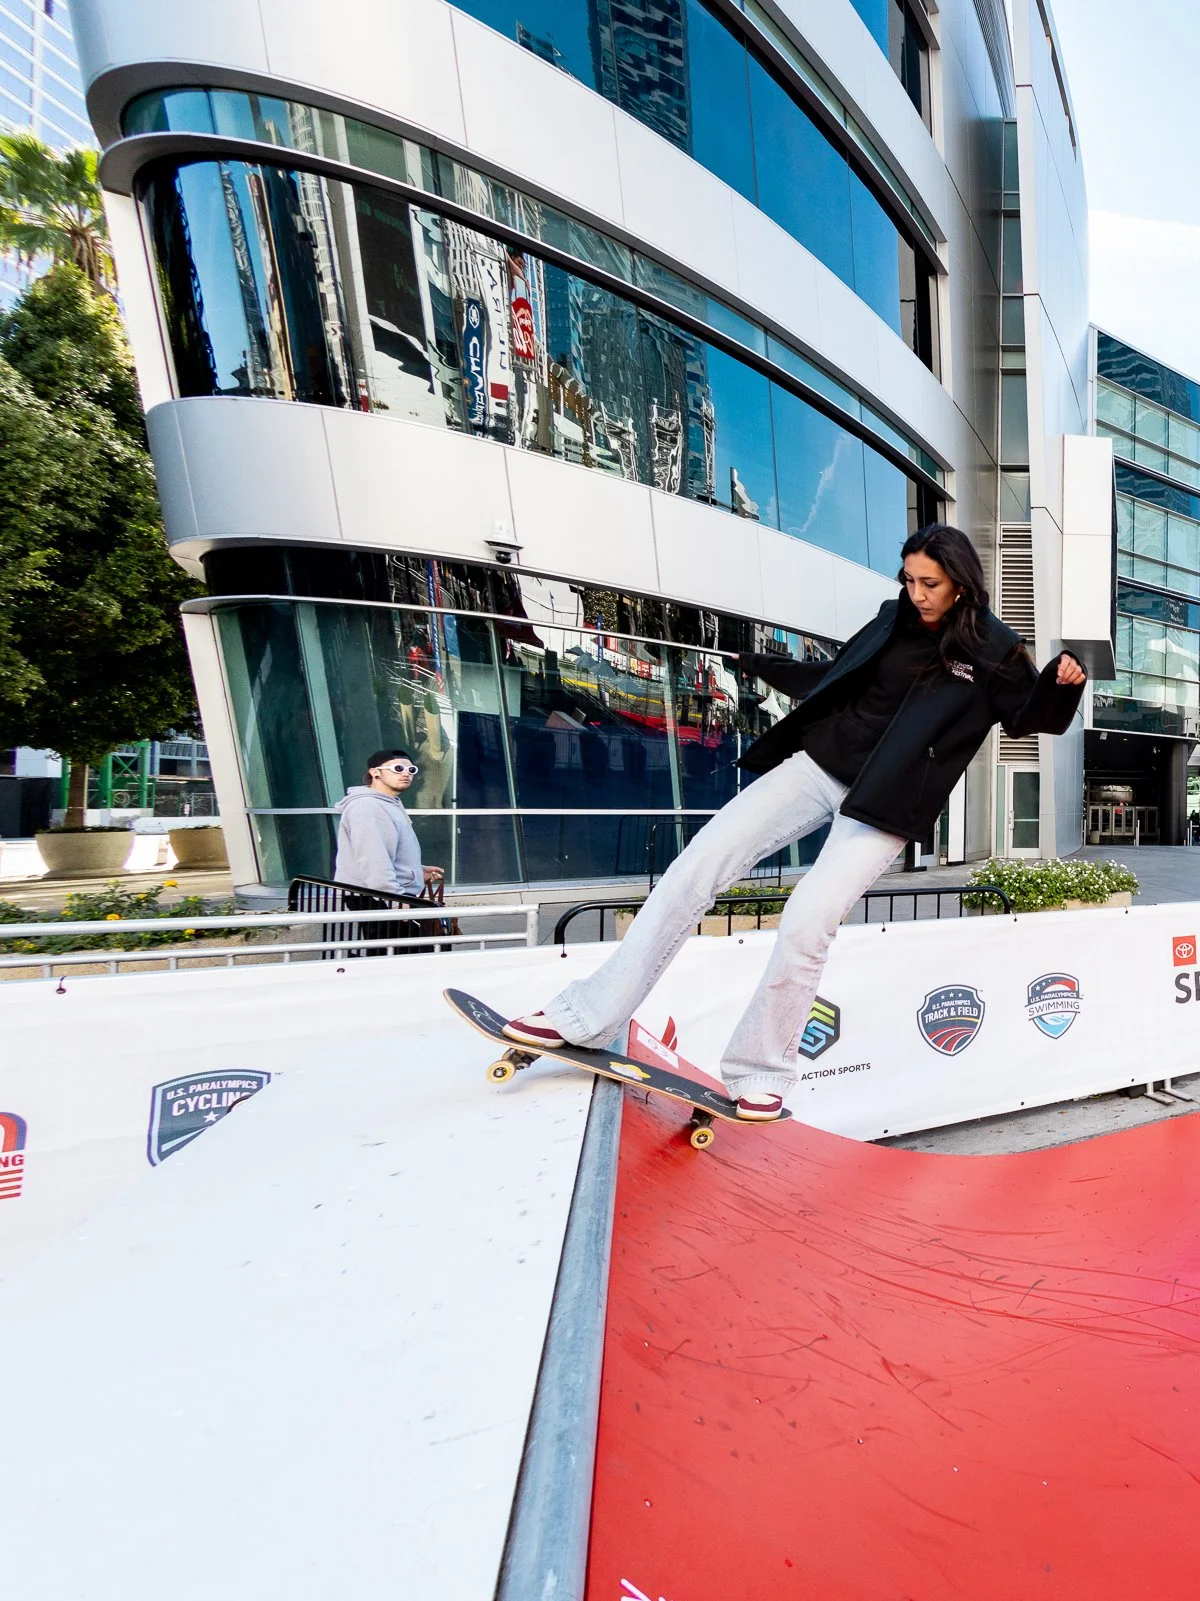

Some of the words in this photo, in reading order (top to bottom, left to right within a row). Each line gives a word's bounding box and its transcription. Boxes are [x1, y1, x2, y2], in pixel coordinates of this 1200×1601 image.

[941, 1000, 971, 1008] PARALYMPICS
[1041, 992, 1077, 1001] PARALYMPICS
[924, 1008, 949, 1024] TRACK
[950, 1006, 956, 1016] &
[958, 1006, 978, 1017] FIELD
[1029, 1001, 1080, 1017] SWIMMING
[801, 1069, 836, 1081] ACTION
[838, 1062, 872, 1075] SPORTS
[166, 1088, 187, 1100] U.S.
[189, 1080, 258, 1094] PARALYMPICS
